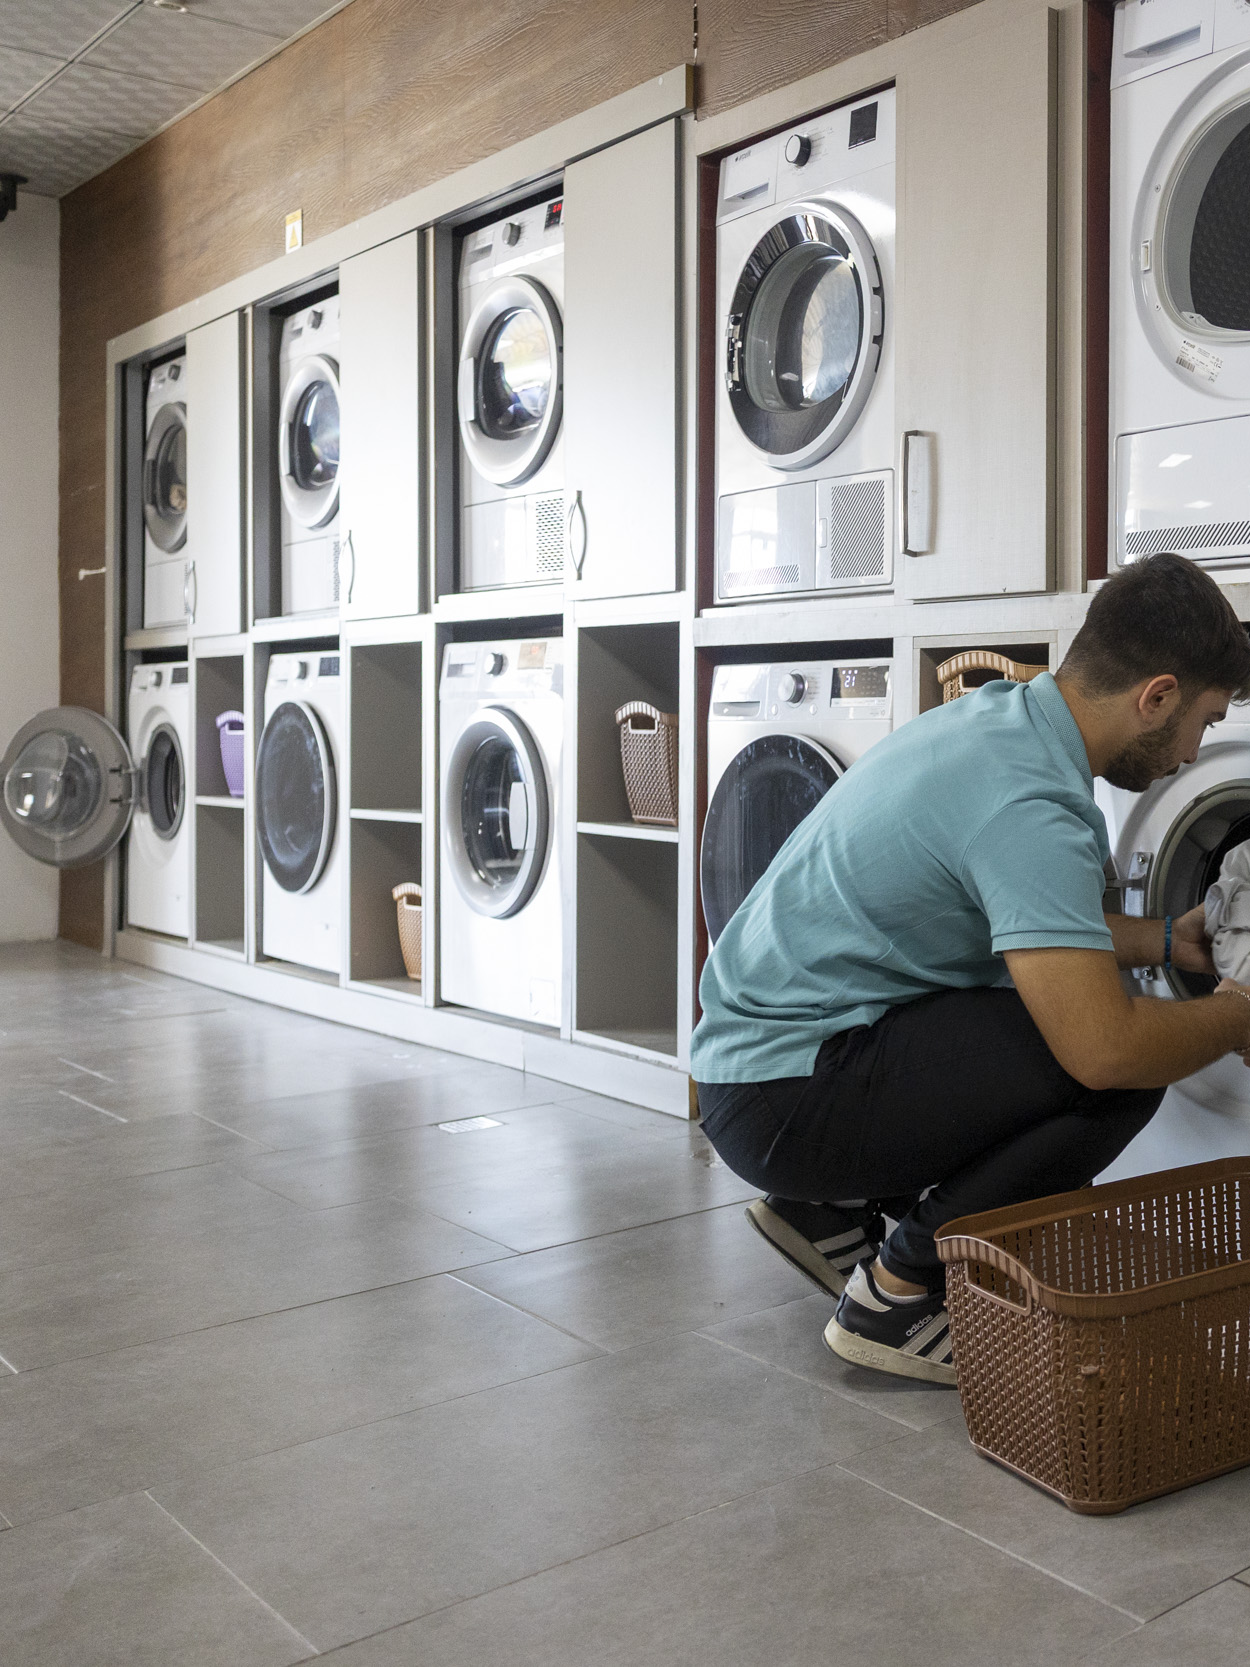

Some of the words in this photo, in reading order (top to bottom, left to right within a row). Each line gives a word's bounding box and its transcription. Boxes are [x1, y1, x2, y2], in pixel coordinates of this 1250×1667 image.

[844, 675, 856, 688] 21
[906, 1314, 933, 1337] adidas
[848, 1348, 885, 1366] adidas
